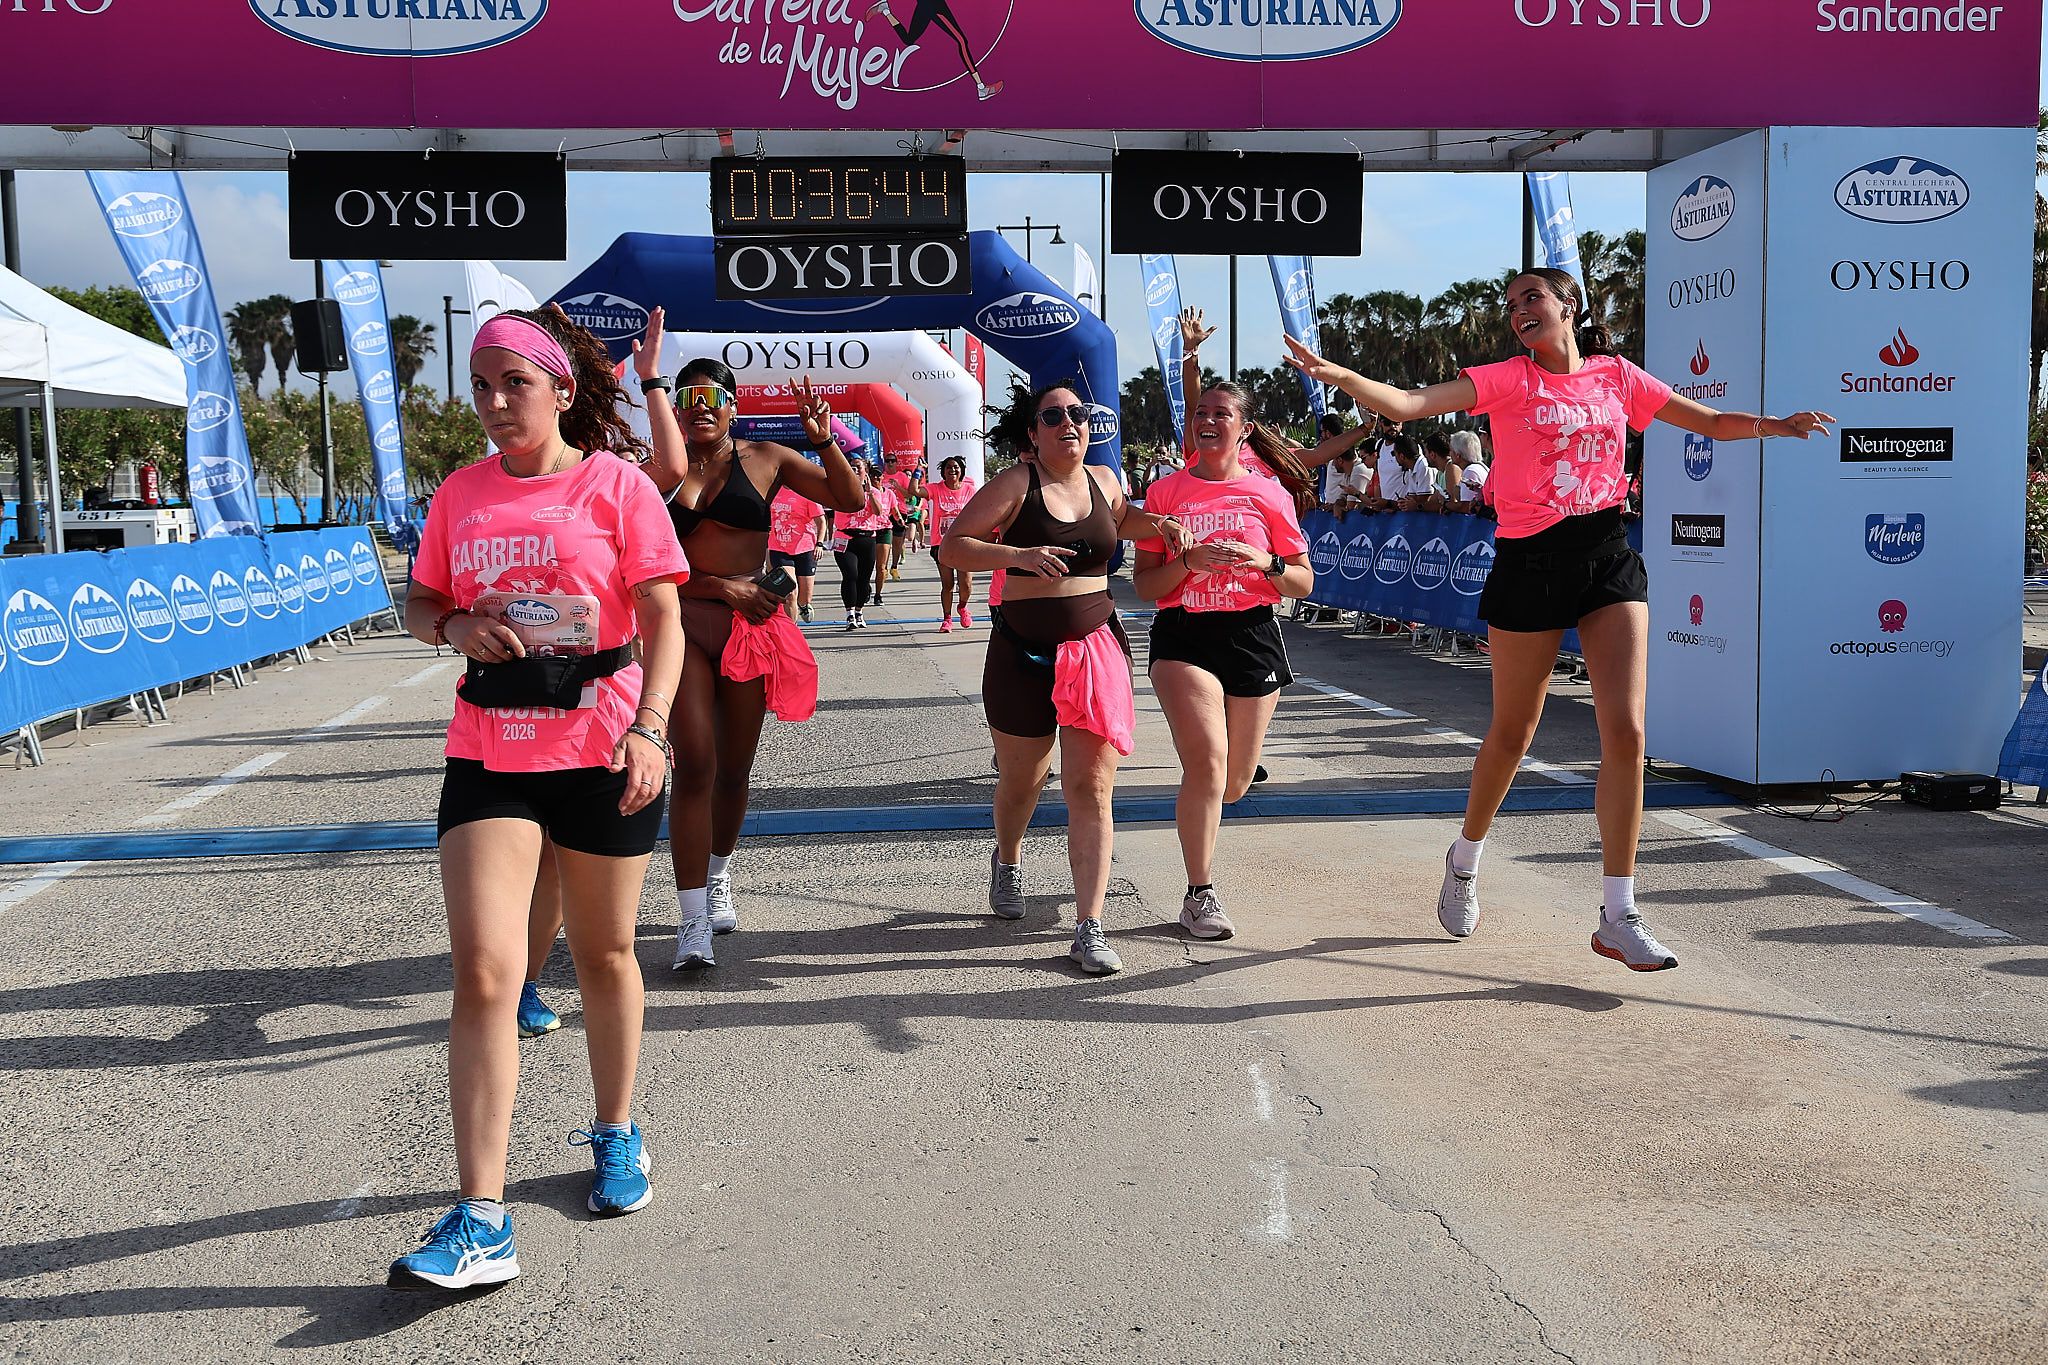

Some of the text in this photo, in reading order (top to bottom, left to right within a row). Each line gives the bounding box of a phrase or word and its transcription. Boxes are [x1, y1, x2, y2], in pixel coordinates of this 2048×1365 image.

[1514, 0, 1711, 27] OYSHO
[1816, 0, 2003, 32] Santander
[719, 24, 921, 110] de la Mujer
[730, 168, 949, 220] 00:36:44
[1153, 184, 1328, 224] OYSHO
[1844, 180, 1960, 206] ASTURIANA
[334, 189, 526, 228] OYSHO
[1675, 200, 1730, 230] ASTURIANA
[728, 241, 958, 292] OYSHO
[1830, 260, 1970, 291] OYSHO
[1668, 268, 1735, 308] OYSHO
[568, 314, 642, 329] STURIANA
[985, 311, 1075, 329] ASTURIANA
[998, 304, 1068, 316] CENTRAL LECHERA
[722, 340, 869, 370] OYSHO
[912, 369, 955, 380] OYSHO
[1840, 372, 1956, 393] Santander
[1685, 443, 1712, 468] Marlene
[1848, 435, 1945, 457] Neutrogena
[77, 511, 125, 520] 6517
[1674, 520, 1721, 543] Neutrogena
[1868, 524, 1921, 551] Marlene
[452, 534, 559, 576] CARRERA
[1413, 556, 1447, 578] ASTURIANA
[1901, 550, 1917, 561] ALPES
[509, 606, 556, 621] ASTURIANA
[1181, 593, 1236, 609] MUJER
[74, 611, 126, 639] ASTURIANA
[130, 603, 174, 629] ASTURIANA
[13, 623, 67, 650] ASTURIANA
[1667, 629, 1728, 654] octopus energy
[1829, 639, 1955, 657] octopus energy
[502, 723, 536, 740] 2026
